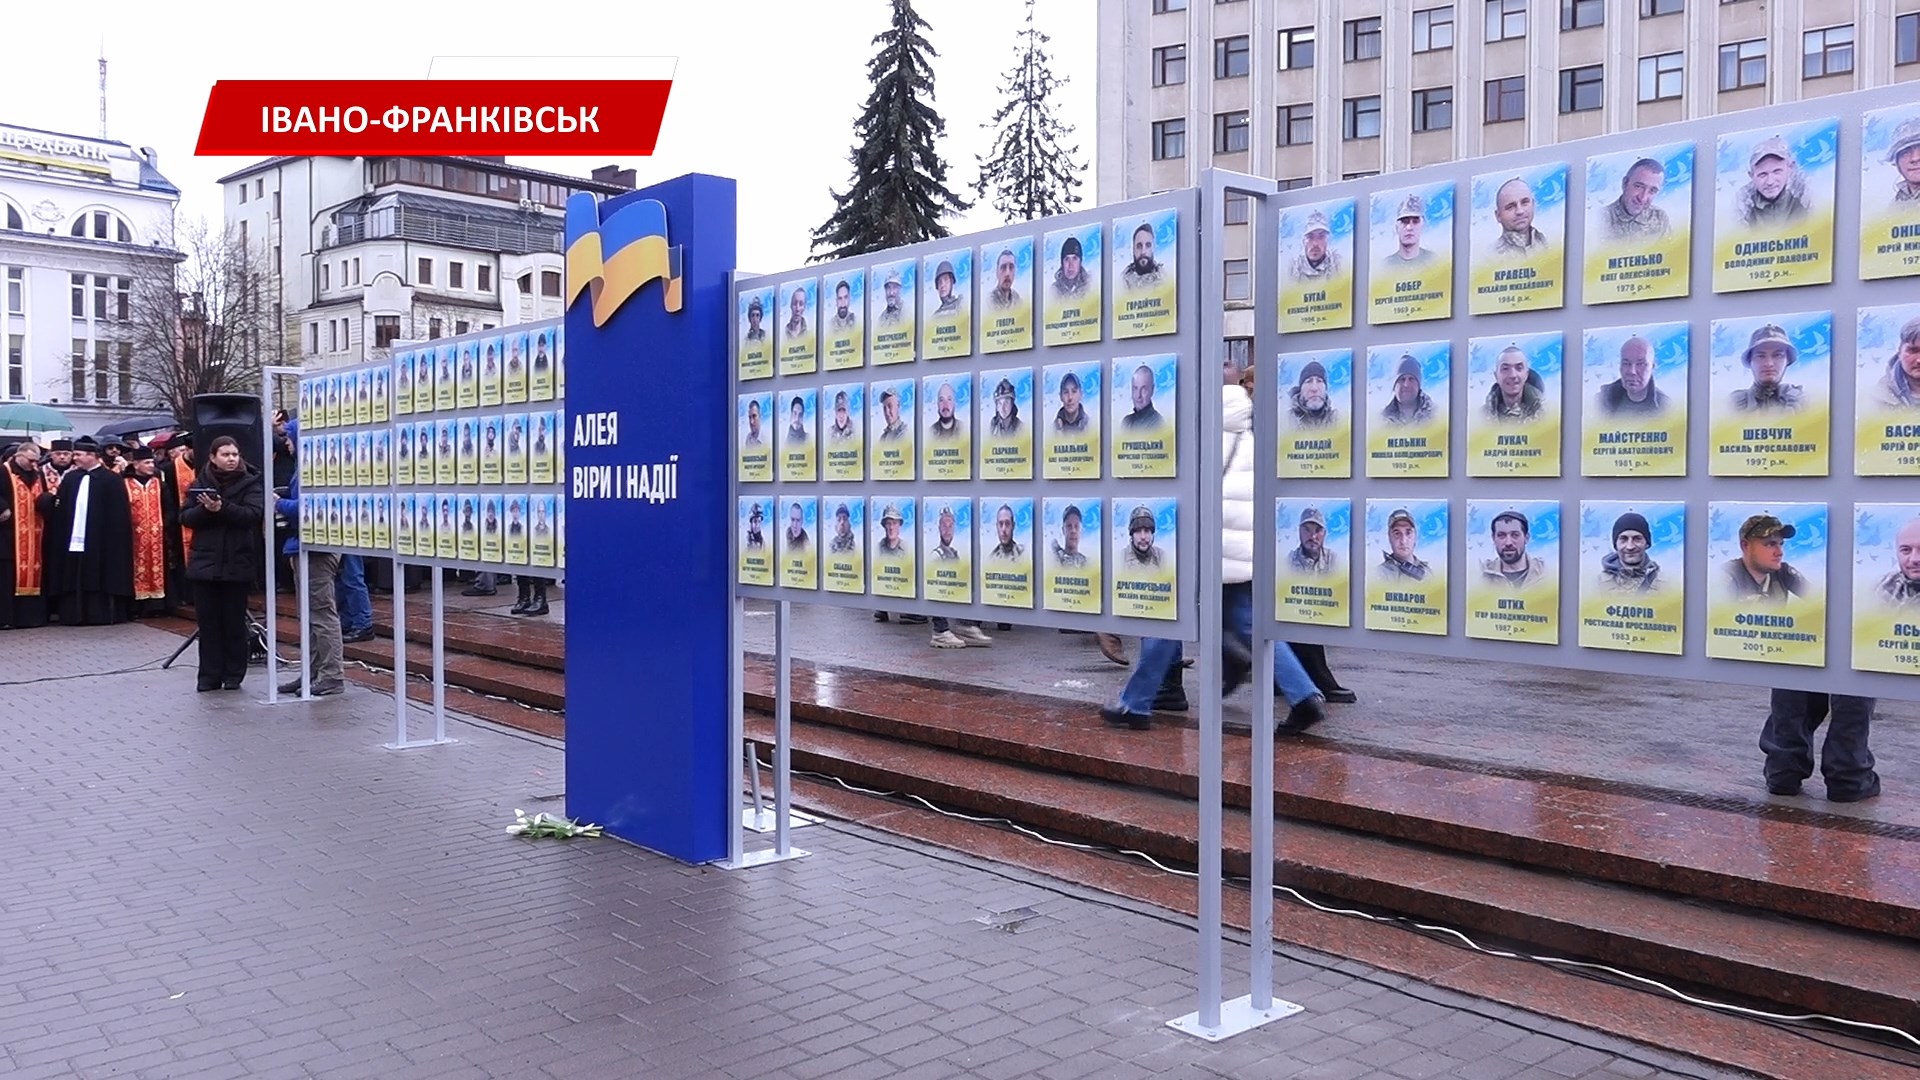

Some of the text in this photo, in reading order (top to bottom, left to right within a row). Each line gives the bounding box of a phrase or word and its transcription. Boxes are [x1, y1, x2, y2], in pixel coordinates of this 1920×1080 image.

[1734, 234, 1809, 257] ОДИНСЬКИЙ
[1877, 242, 1902, 254] ЮРІЙ
[1608, 253, 1663, 270] МЕТЕНЬКО
[1724, 252, 1819, 270] ВОЛОДИМИР ІВАНОВИЧ
[1494, 268, 1537, 281] КРАВЕЦЬ
[1600, 267, 1671, 282] ОЛЕГ ОЛЕКСІЙОВИЧ
[1749, 270, 1771, 279] 1982
[1395, 280, 1422, 292] БОБЕР
[1477, 279, 1554, 295] МИХАЙЛО МИХАЙЛОВИЧ
[1616, 284, 1635, 292] 1978
[1303, 290, 1326, 303] БУГАЙ
[1375, 291, 1444, 305] СЕРГІЙ ОЛЕКСАНДРОВИЧ
[1126, 298, 1162, 311] ГОРДІЙЧУК
[573, 411, 618, 447] АЛЕЯ
[1742, 427, 1792, 441] ШЕВЧУК
[1387, 437, 1427, 448] МЕЛЬНИК
[1497, 435, 1528, 446] ЛУКАЧ
[1599, 431, 1668, 444] МАЙСТРЕНКО
[1122, 440, 1164, 451] ГРУШЕЦЬКИЙ
[1294, 438, 1332, 450] ПАРАНДІЙ
[1719, 443, 1816, 454] ВАСИЛЬ ЯРОСЛАВОВИЧ
[1881, 441, 1904, 451] ЮРІЙ
[1305, 452, 1340, 460] БОГДАНОВИЧ
[1394, 450, 1443, 459] ВОЛОДИМИРОВИЧ
[1484, 448, 1542, 458] АНДРІЙ ІВАНОВИЧ
[1592, 446, 1674, 456] СЕРГІЙ АНАТОЛІЙОВИЧ
[1745, 458, 1767, 466] 1997
[573, 466, 611, 499] ВІРИ
[616, 465, 622, 499] І
[627, 454, 679, 504] НАДІЇ
[1116, 580, 1172, 593] ДРАГОМИРЕЦЬКИЙ
[1290, 585, 1333, 598] ОСТАПЕНКО
[1385, 592, 1425, 604] ШКВАРОК
[1370, 604, 1441, 616] РОМАН ВОЛОДИМИРОВИЧ
[1498, 599, 1525, 611] ШТИХ
[1475, 611, 1548, 624] ІГОР ВОЛОДИМИРОВИЧ
[1605, 605, 1654, 620] ФЕДОРІВ
[1584, 618, 1677, 633] РОСТИСЛАВ ЯРОСЛАВОВИЧ
[1735, 613, 1794, 629] ФОМЕНКО
[1713, 628, 1817, 643] ОЛЕКСАНДР МАКСИМОВИЧ
[1743, 642, 1764, 651] 2001
[1879, 640, 1908, 649] СЕРГІЙ
[1895, 655, 1919, 664] 1985
